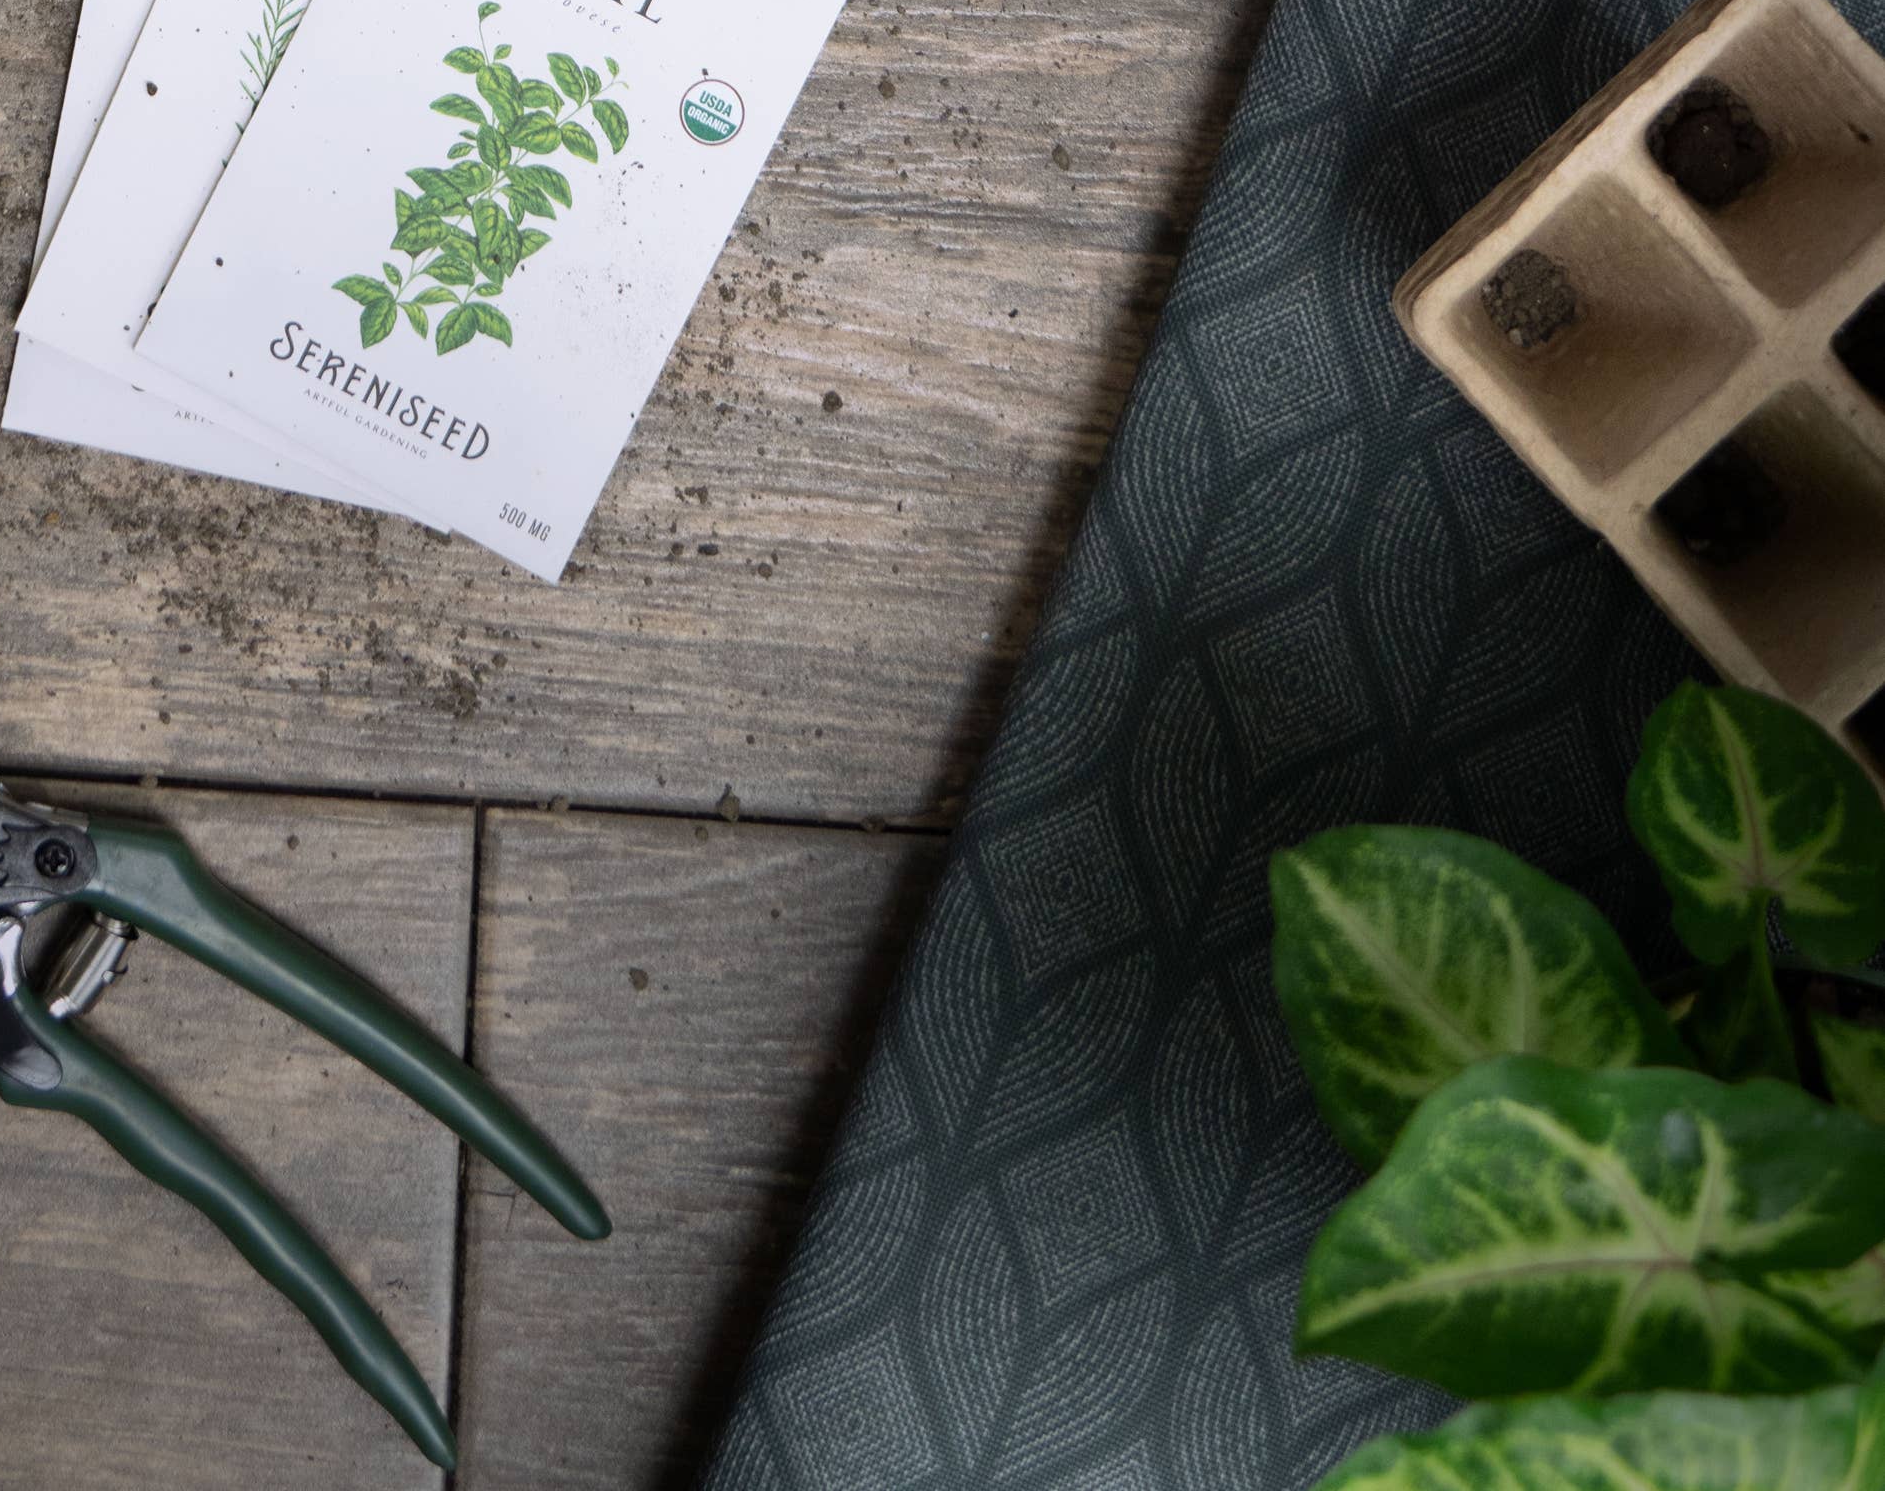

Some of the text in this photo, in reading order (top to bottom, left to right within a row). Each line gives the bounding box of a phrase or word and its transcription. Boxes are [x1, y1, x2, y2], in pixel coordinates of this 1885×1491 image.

[687, 105, 731, 135] ORGANIC
[699, 90, 733, 118] USDA
[269, 320, 491, 461] SERENISEED
[302, 387, 429, 460] ARTFUL GARDENING
[498, 501, 553, 544] 500 MG
